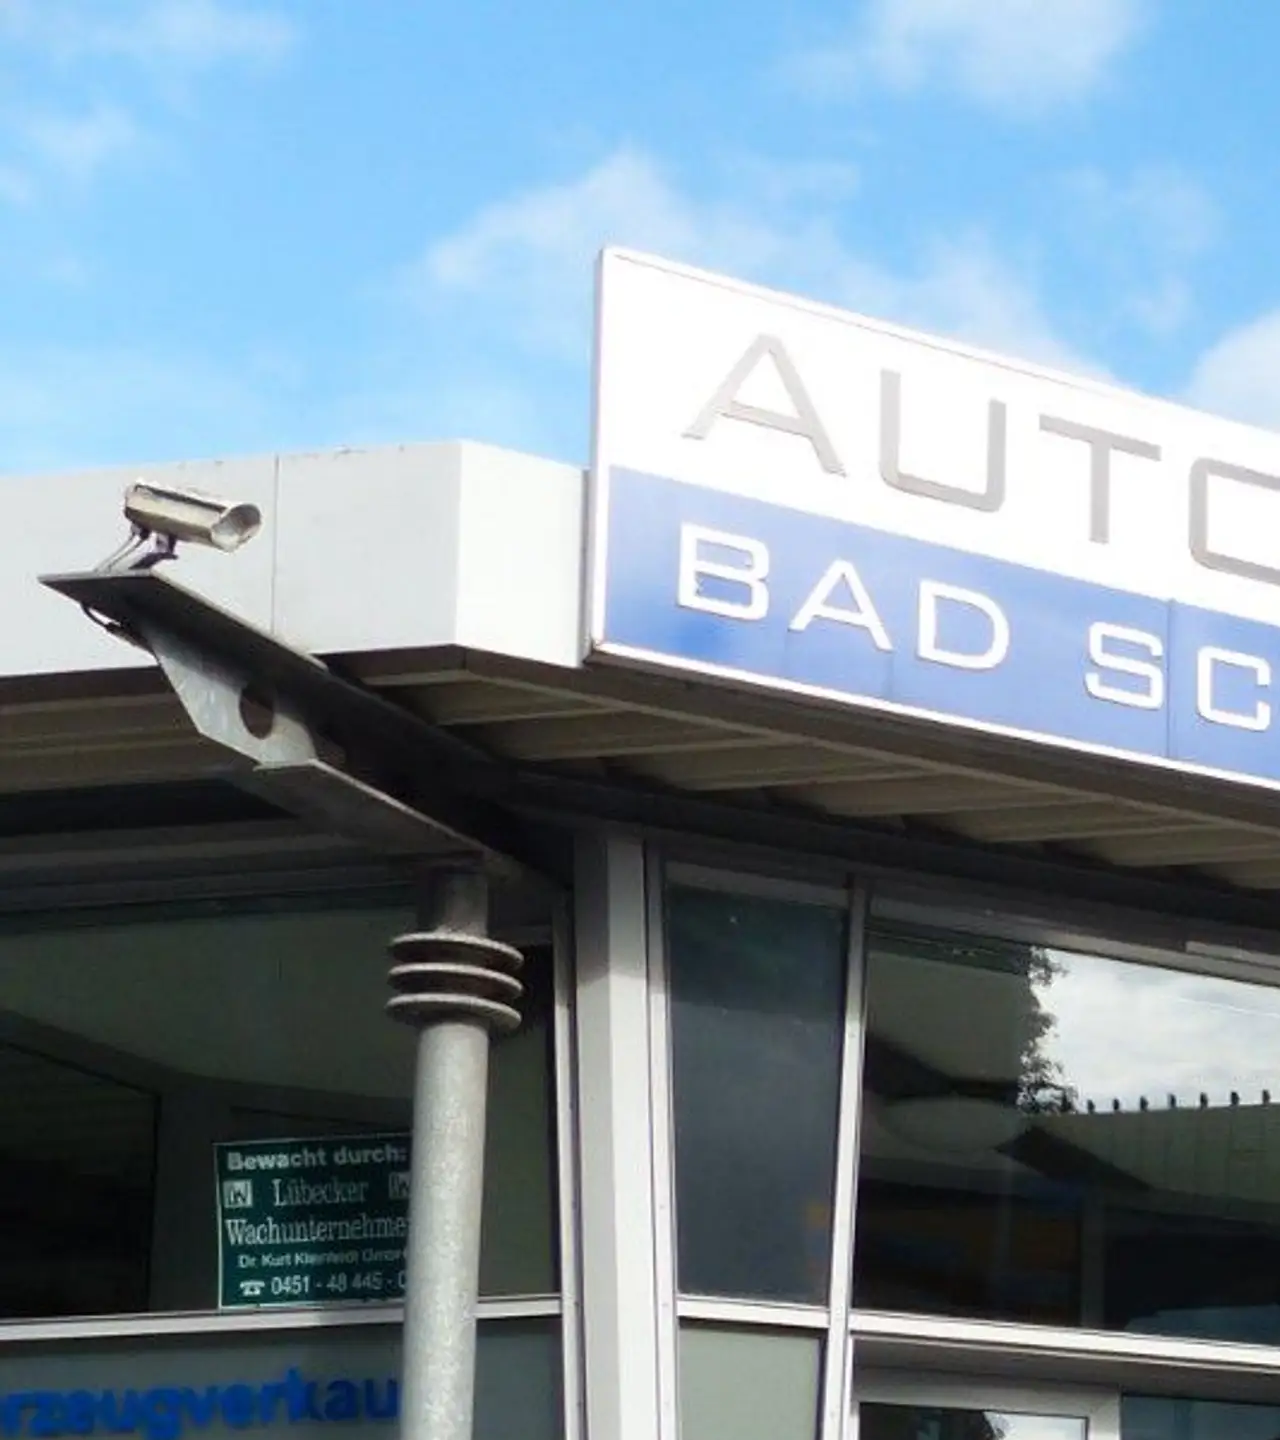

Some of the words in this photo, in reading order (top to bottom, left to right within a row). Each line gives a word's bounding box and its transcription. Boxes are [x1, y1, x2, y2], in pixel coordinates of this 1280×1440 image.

[676, 522, 1010, 672] BAD
[227, 1149, 328, 1170] Bewacht
[334, 1145, 407, 1165] durch:
[272, 1176, 368, 1207] Lübecker
[225, 1212, 411, 1246] Wachunternehme
[271, 1274, 310, 1295] 0451
